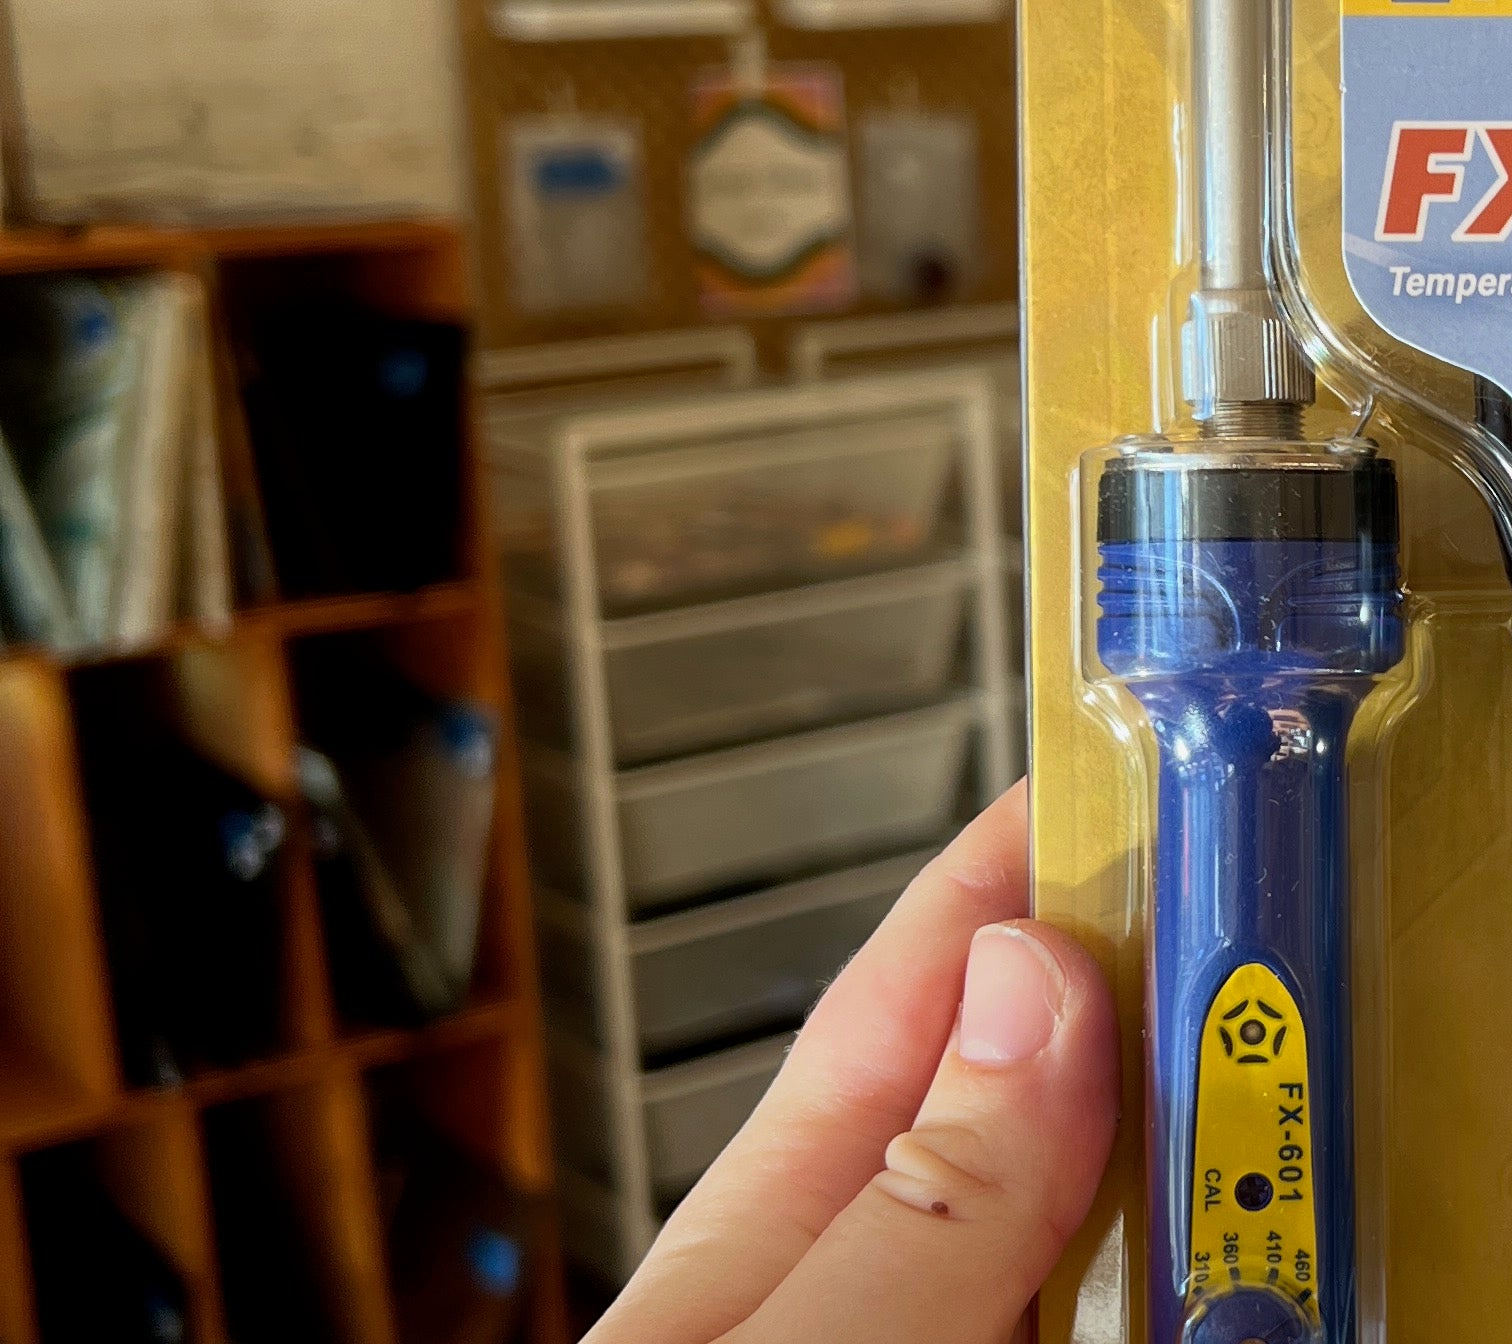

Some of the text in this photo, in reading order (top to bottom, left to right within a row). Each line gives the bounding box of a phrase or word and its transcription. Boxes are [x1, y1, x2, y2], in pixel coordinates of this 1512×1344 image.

[1278, 1082, 1304, 1201] FX-601
[1204, 1168, 1221, 1213] CAL
[1222, 1231, 1239, 1264] 360
[1266, 1230, 1282, 1264] 410
[1194, 1251, 1210, 1283] 310
[1294, 1248, 1311, 1283] 460
